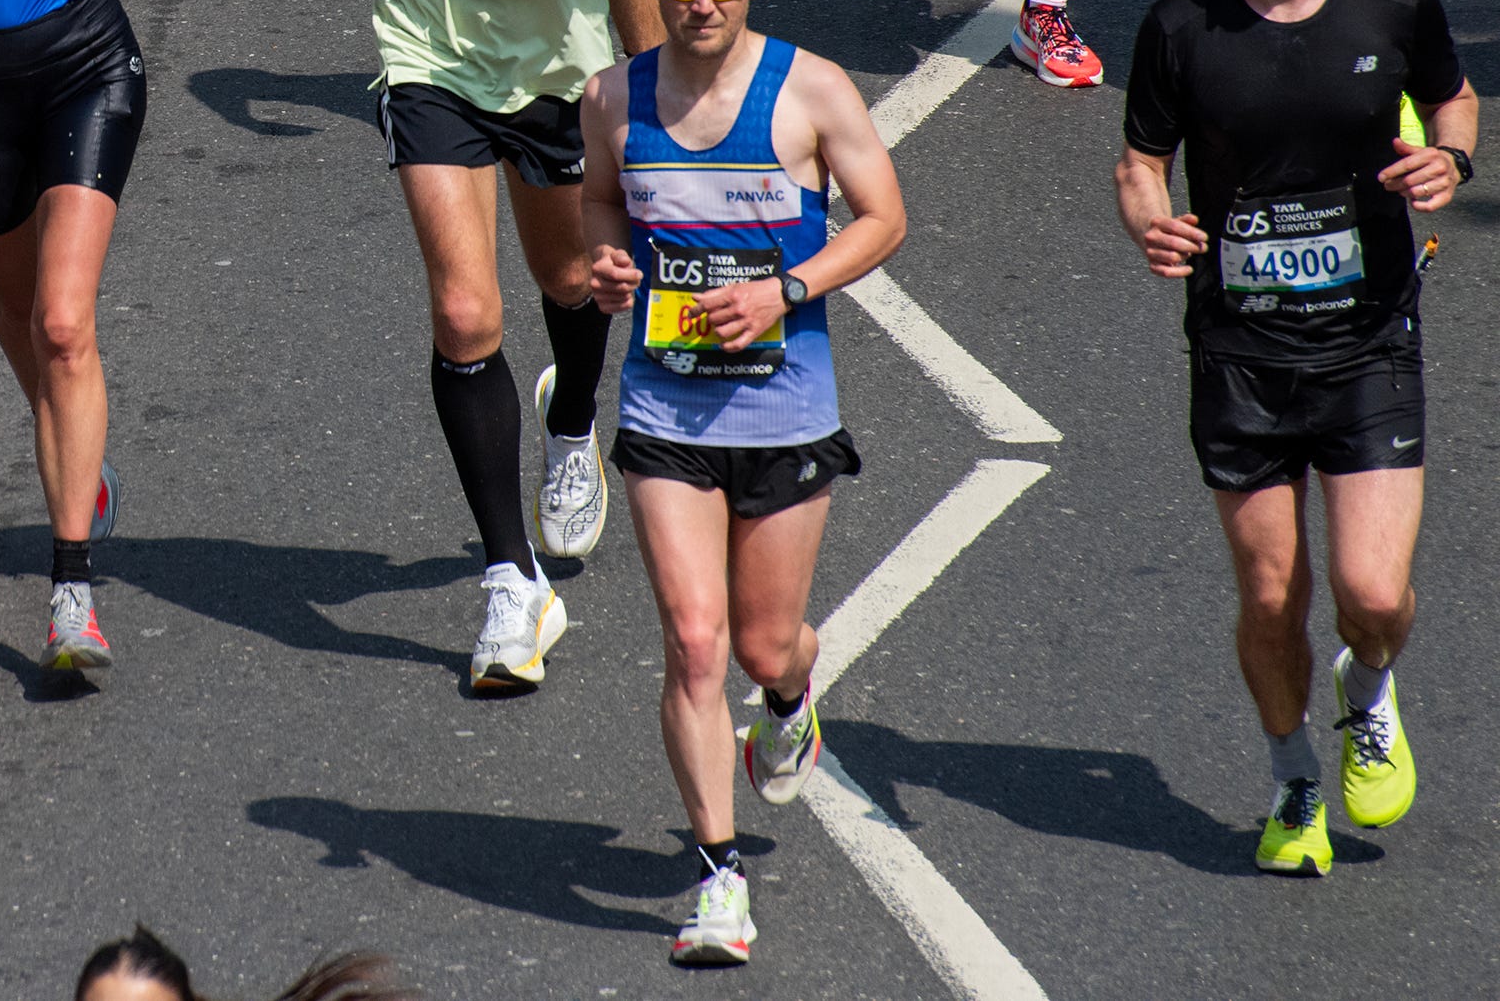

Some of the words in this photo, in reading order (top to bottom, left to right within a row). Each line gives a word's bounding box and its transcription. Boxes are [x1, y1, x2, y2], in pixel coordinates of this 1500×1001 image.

[726, 190, 785, 203] PANVAC
[1272, 202, 1305, 213] TATA
[1274, 205, 1347, 223] CONSULTANCY
[1275, 220, 1322, 233] SERVICES
[708, 255, 737, 265] TATA
[1241, 245, 1340, 282] 44900
[659, 252, 703, 286] tcs
[708, 264, 775, 276] CONSULTANCY
[1281, 303, 1304, 313] new
[1306, 298, 1356, 312] balance
[698, 366, 721, 375] new
[724, 364, 774, 375] balance
